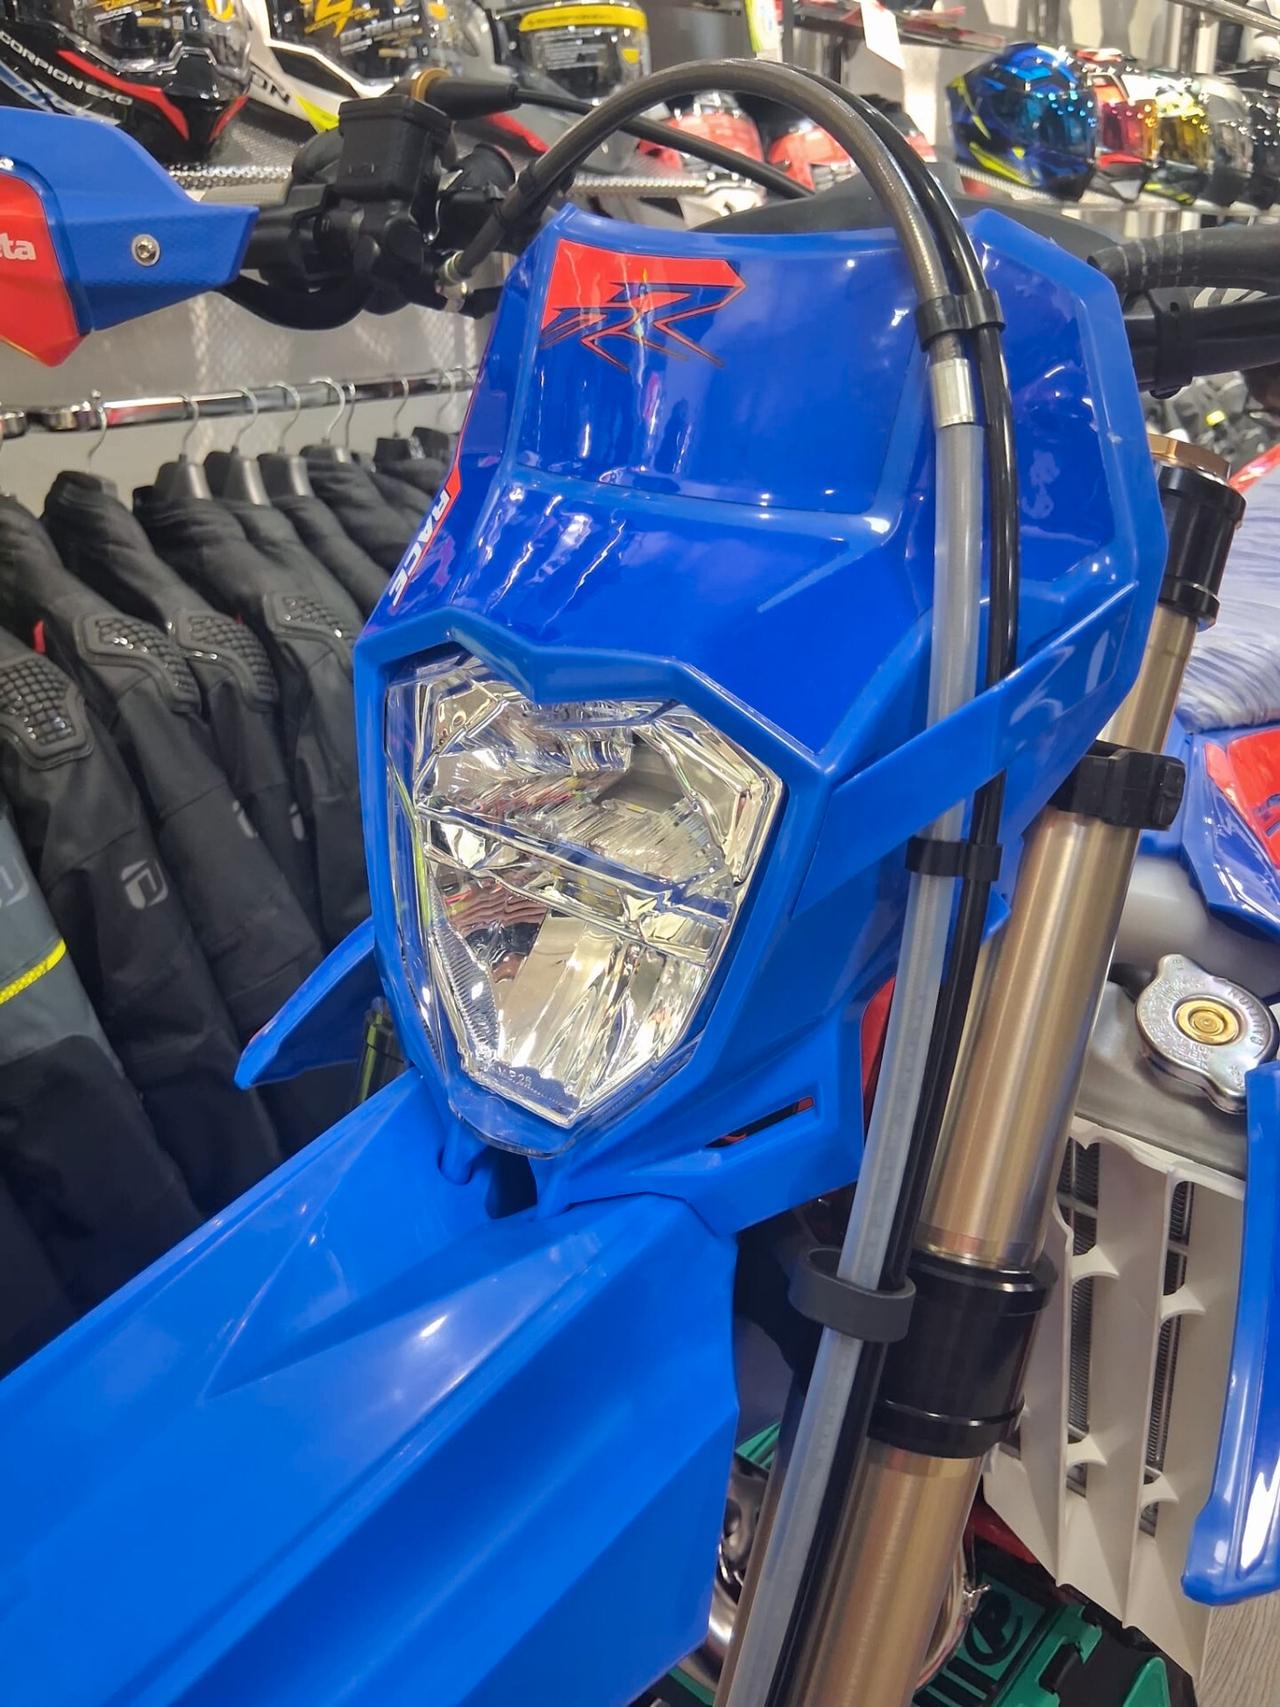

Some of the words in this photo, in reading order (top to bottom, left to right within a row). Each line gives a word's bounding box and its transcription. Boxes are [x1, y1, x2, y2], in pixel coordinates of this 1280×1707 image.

[85, 84, 133, 106] EXO
[0, 232, 37, 261] ta
[388, 488, 451, 607] RACE
